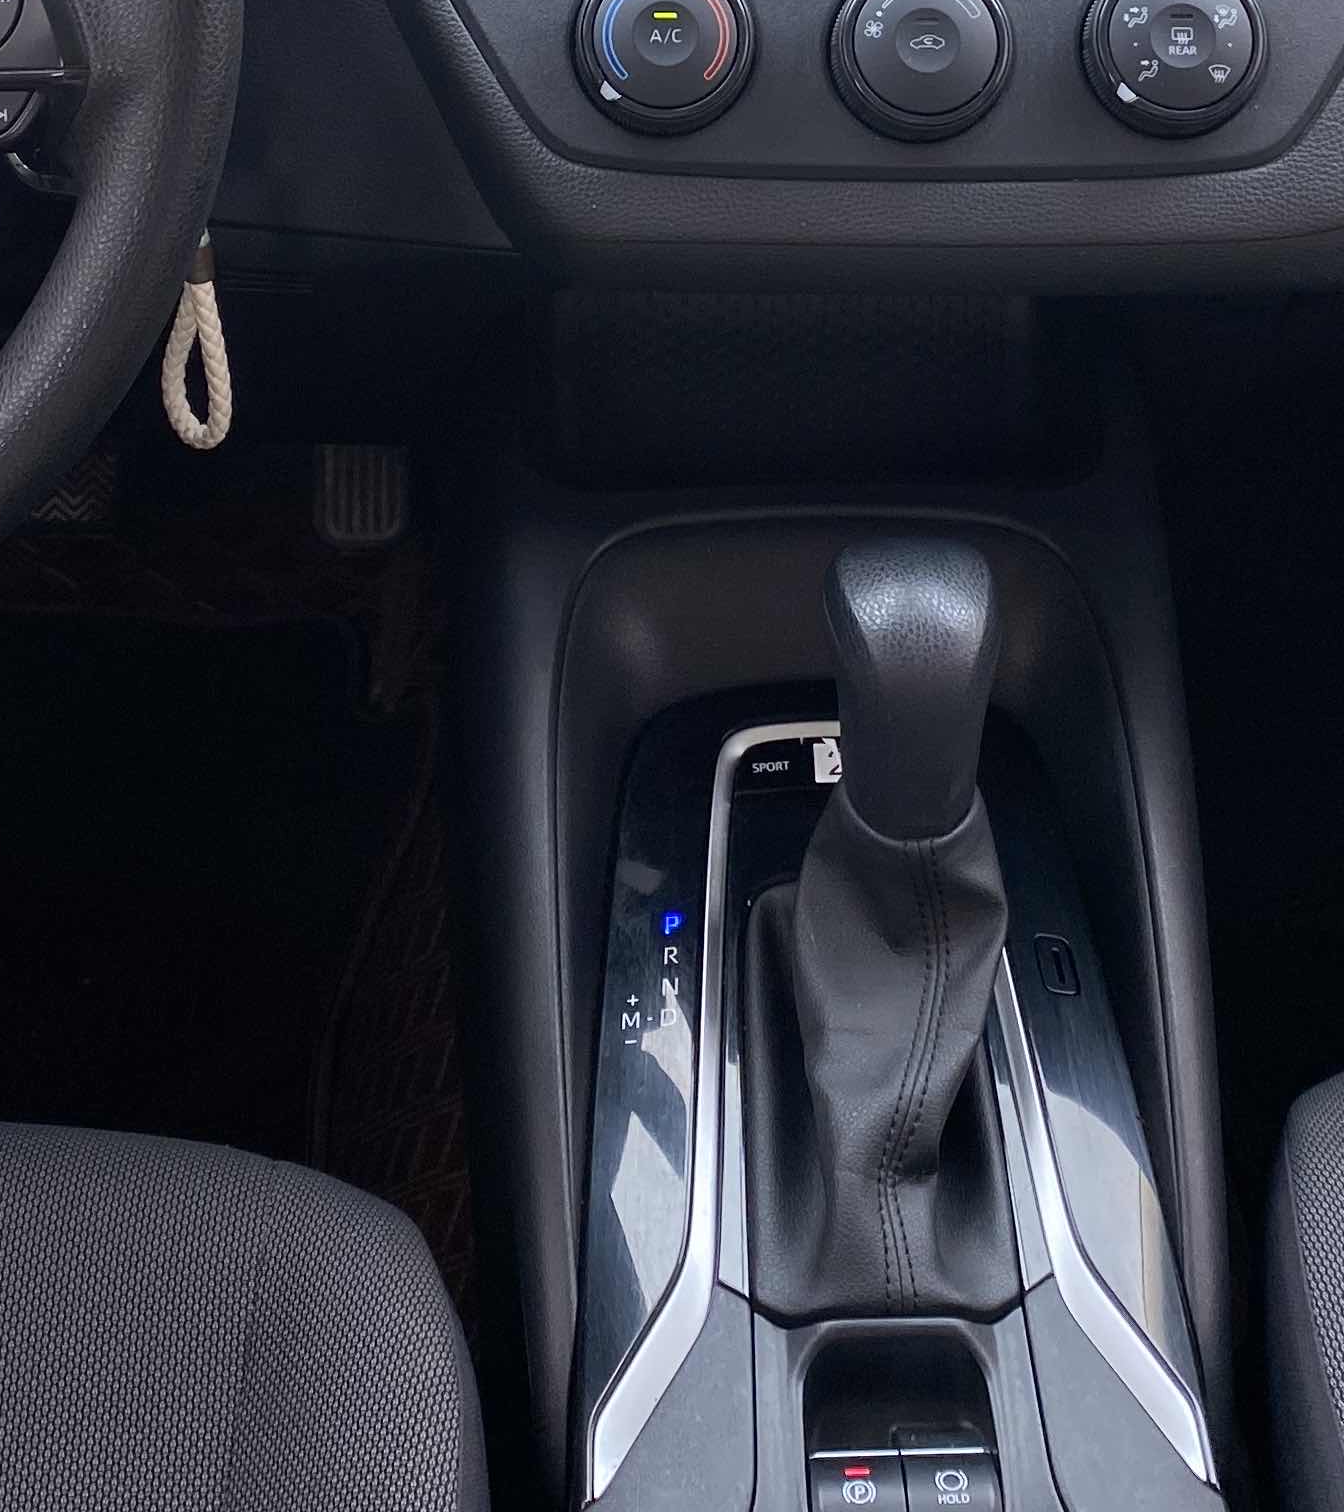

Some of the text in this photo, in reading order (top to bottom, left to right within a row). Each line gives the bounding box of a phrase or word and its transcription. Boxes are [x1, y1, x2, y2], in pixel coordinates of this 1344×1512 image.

[649, 27, 683, 44] A/C
[1168, 45, 1198, 56] REAR
[752, 760, 790, 774] SPORT
[664, 915, 680, 935] P
[663, 946, 679, 965] R
[662, 977, 679, 996] N
[621, 1008, 677, 1030] M D
[937, 1492, 970, 1505] HOLD
